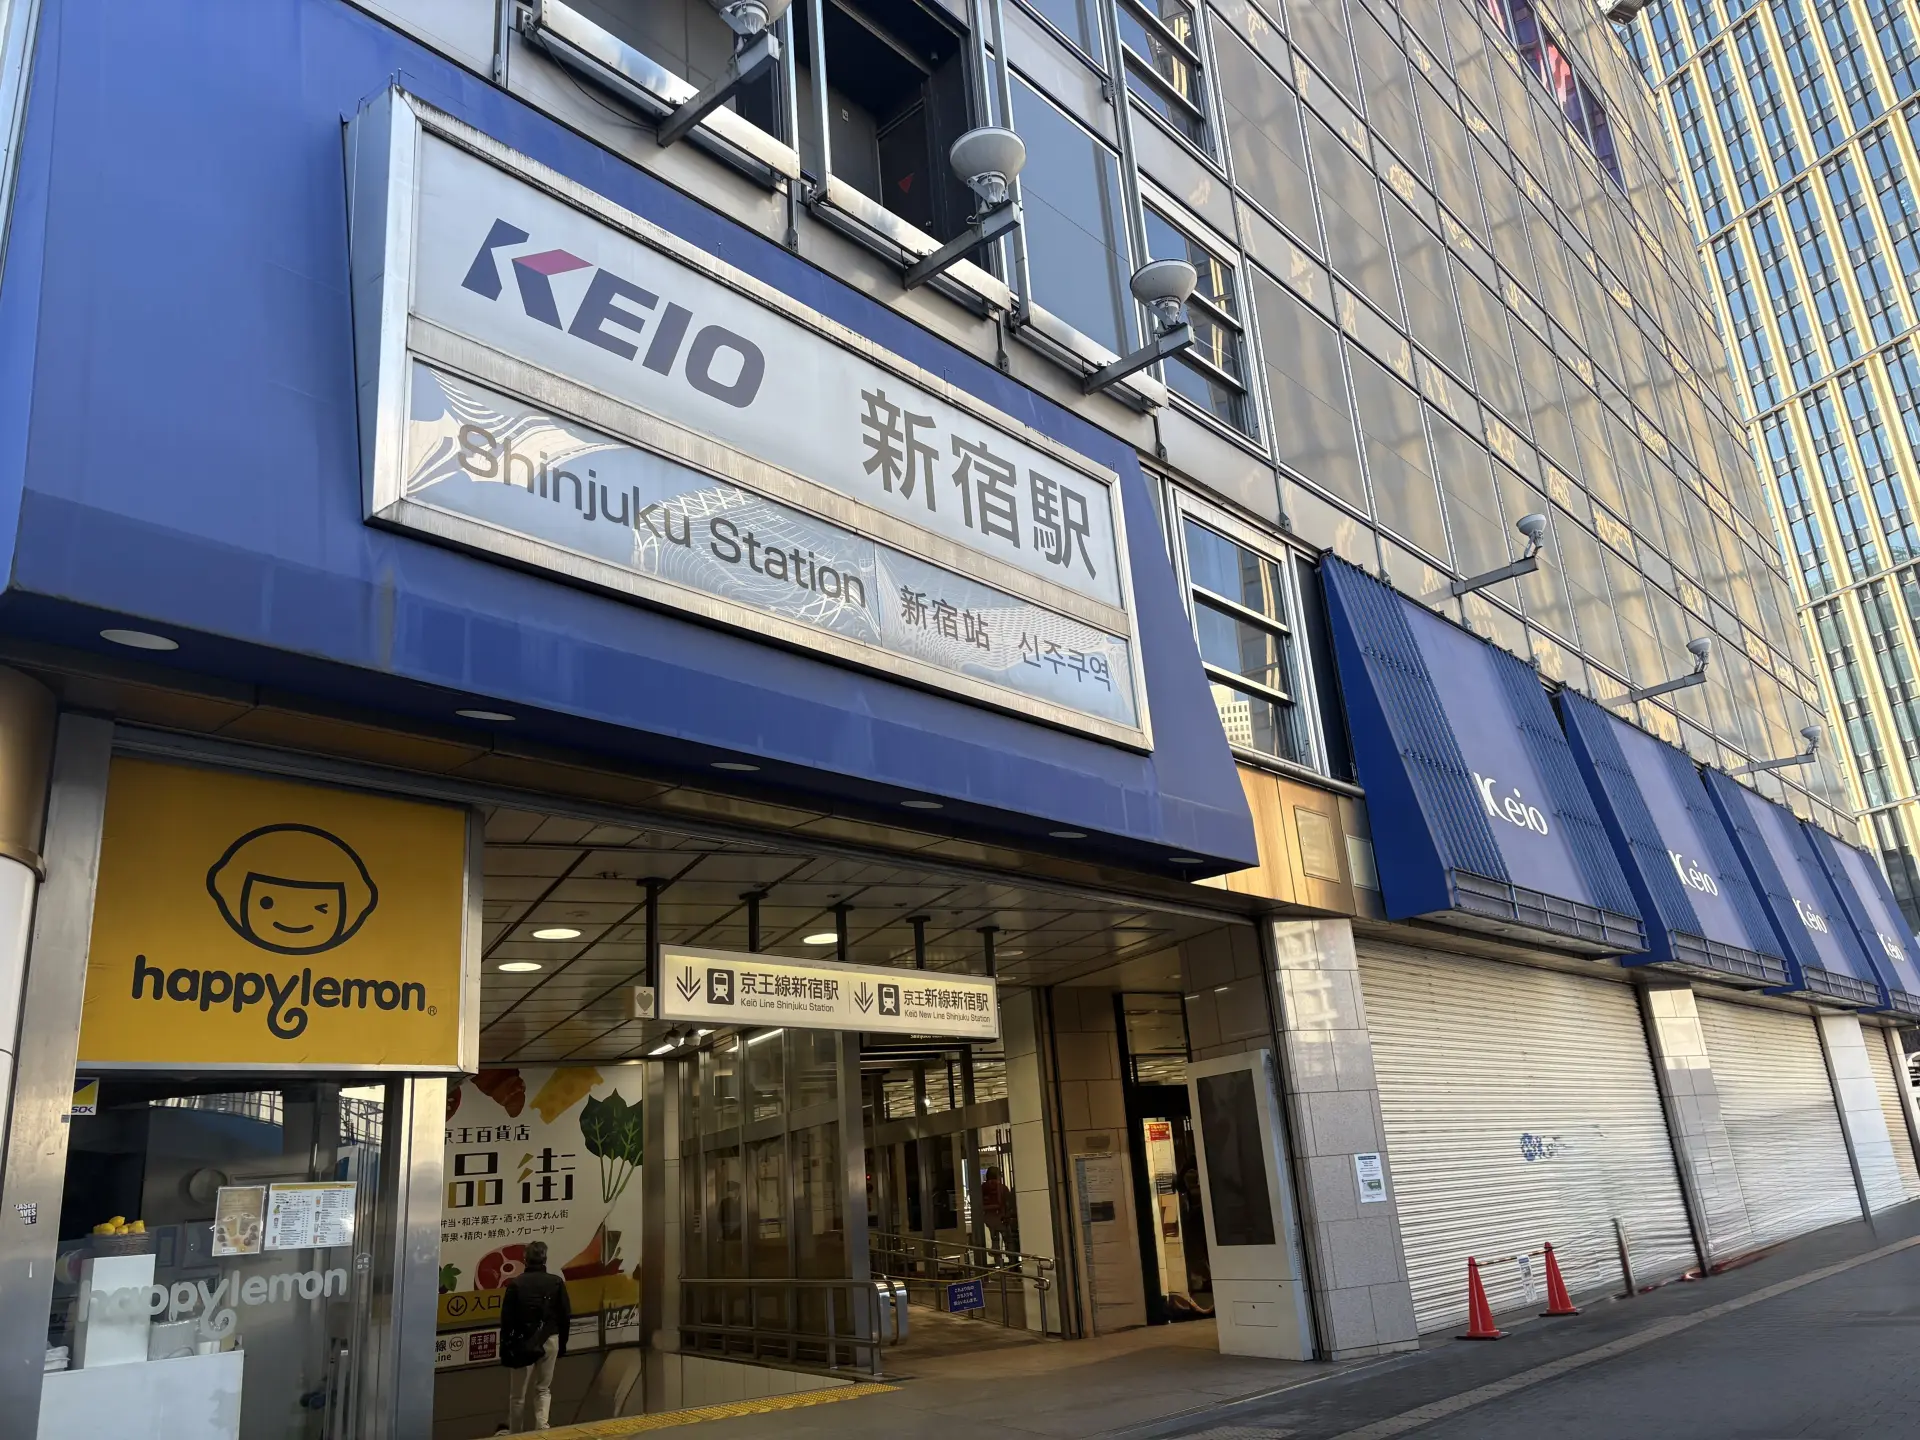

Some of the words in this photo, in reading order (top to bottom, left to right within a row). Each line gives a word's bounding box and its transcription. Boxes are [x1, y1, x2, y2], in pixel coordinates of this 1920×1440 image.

[461, 217, 765, 408] KEIO
[860, 388, 1096, 580] 新宿駅
[457, 424, 691, 548] Shinjuku
[710, 518, 866, 607] Station
[900, 585, 990, 651] 新宿站
[1018, 632, 1111, 692] 신주쿠역
[1474, 773, 1548, 835] Keio
[1667, 850, 1718, 896] Keio
[1793, 898, 1828, 934] Keio
[1877, 931, 1906, 961] Keio
[132, 954, 425, 1039] happylemon
[740, 972, 839, 1001] 京王線新宿駅
[760, 999, 774, 1009] Line
[777, 1001, 807, 1011] Shinjuku
[809, 1004, 834, 1012] Station
[903, 988, 989, 1011] 京王新線新宿駅
[919, 1011, 931, 1019] New
[933, 1012, 945, 1020] Line
[947, 1012, 969, 1021] Shinjuku
[971, 1015, 990, 1023] Station
[78, 1268, 347, 1339] happylemon
[471, 1295, 501, 1312] 入口
[435, 1353, 452, 1363] ine
